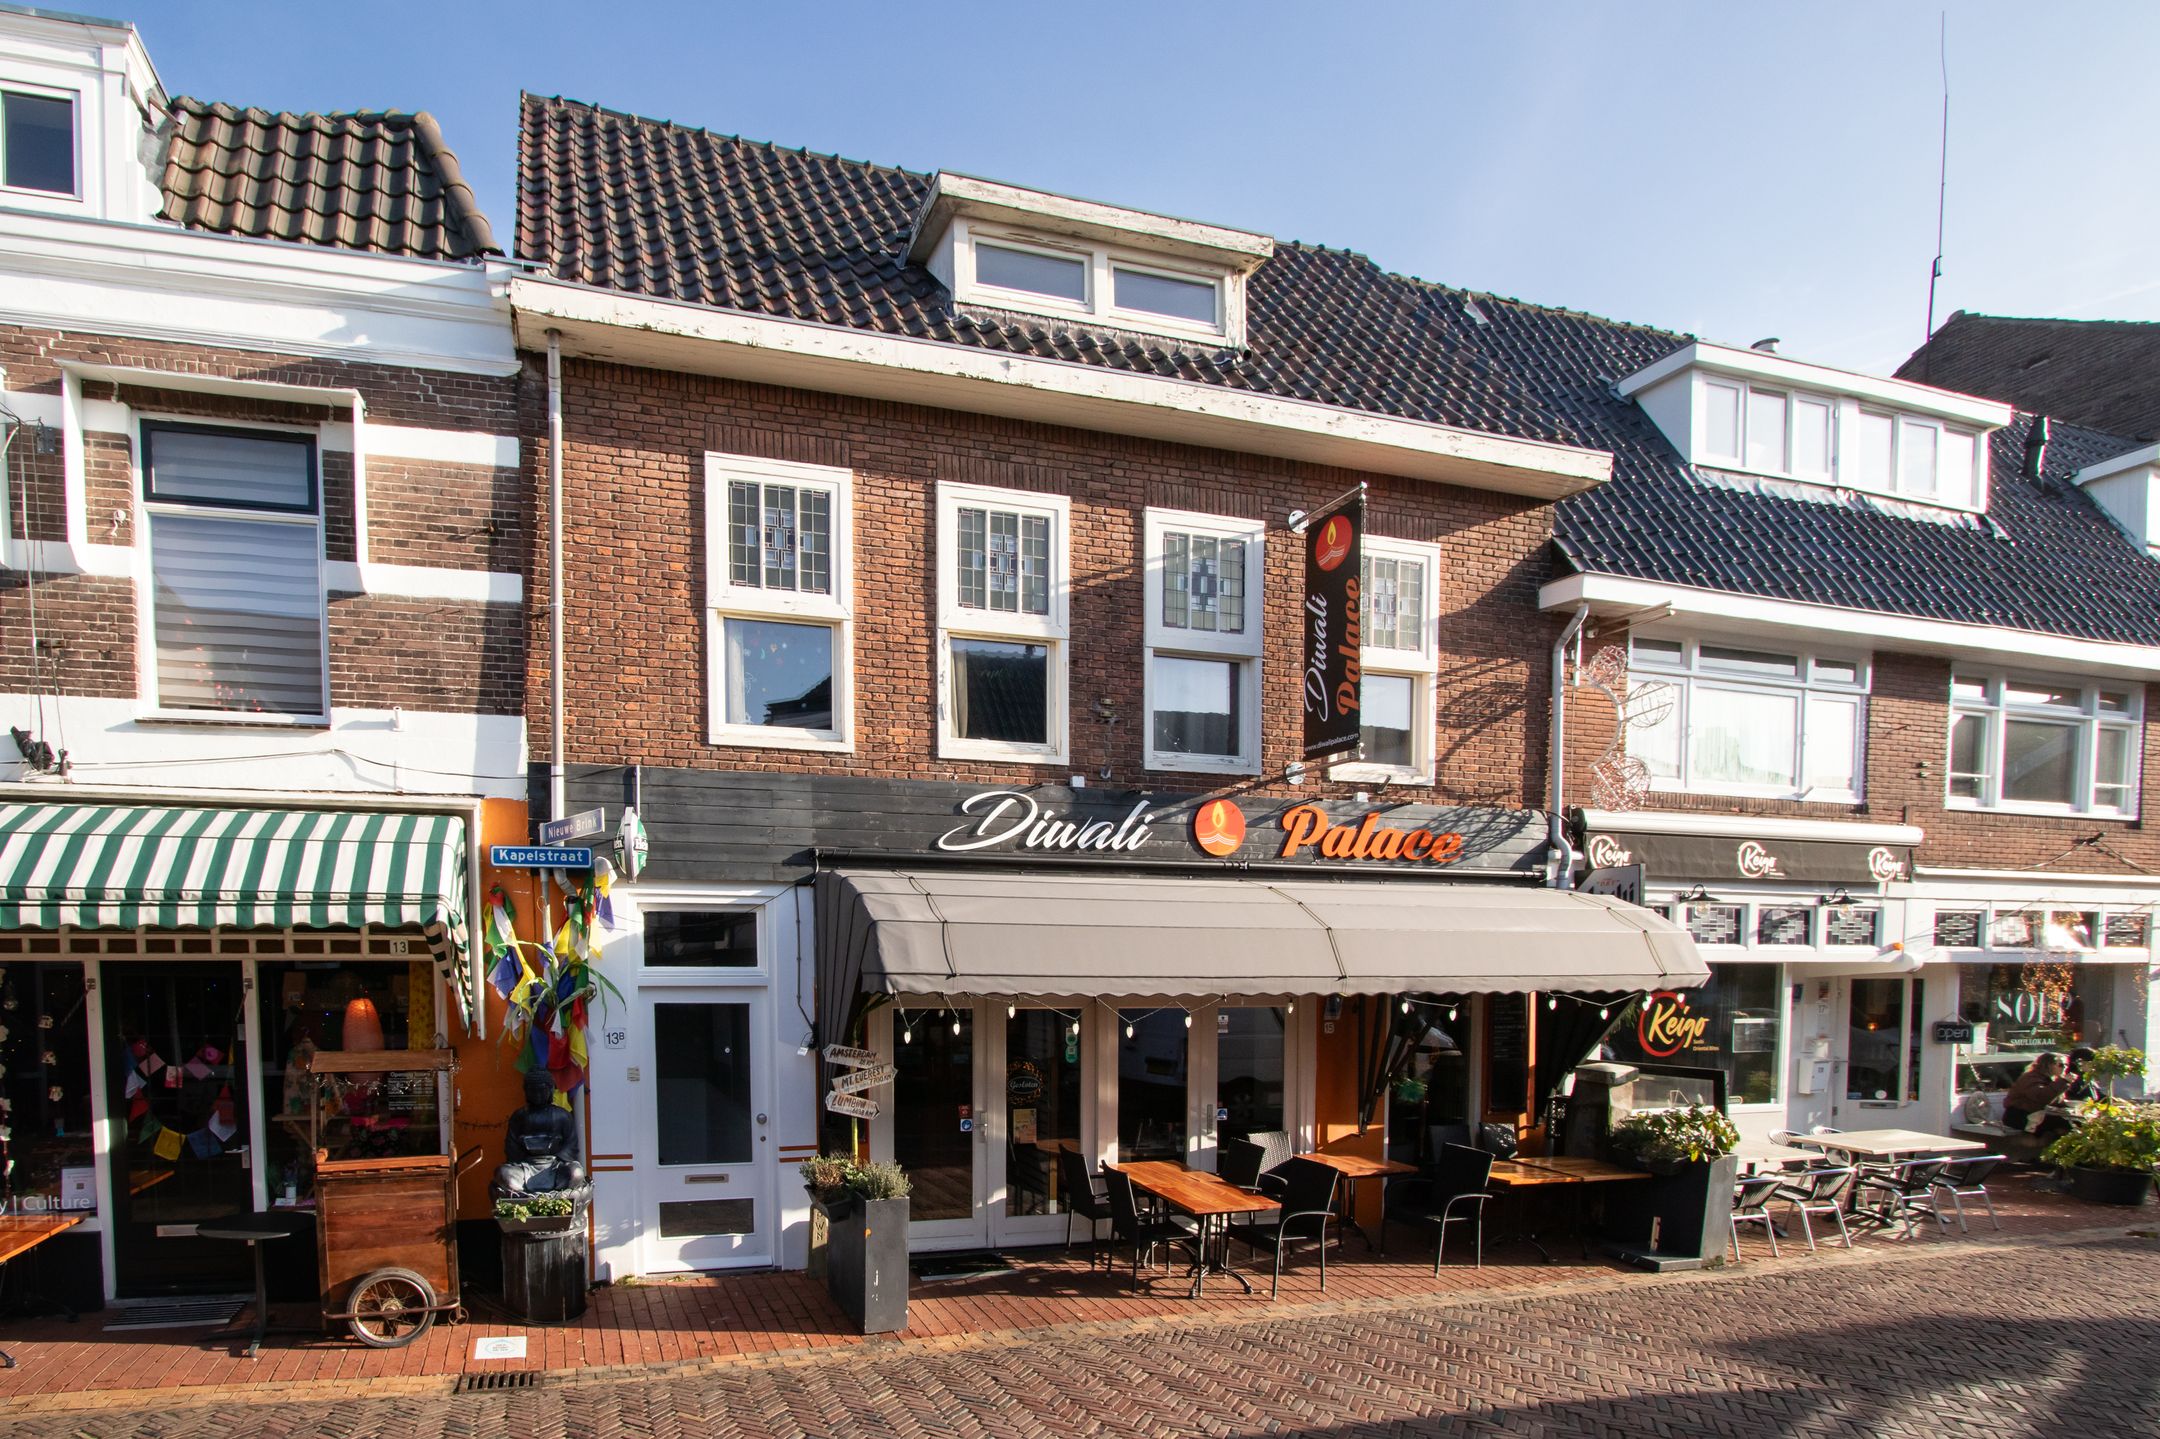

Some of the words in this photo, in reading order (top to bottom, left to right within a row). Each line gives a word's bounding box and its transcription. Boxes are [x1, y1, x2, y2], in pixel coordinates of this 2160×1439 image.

[1336, 575, 1360, 716] Palace
[1304, 592, 1328, 722] Diwali
[1304, 733, 1359, 752] www.diwalipalace.com
[548, 823, 574, 839] Nieuwe
[575, 816, 597, 831] Brink
[937, 790, 1154, 853] Diwali
[1281, 804, 1465, 863] Palace
[499, 849, 583, 863] Kapelstraat
[1596, 842, 1632, 868] Keigo
[1744, 847, 1778, 874] Keigo
[393, 941, 407, 953] 13
[1648, 1002, 1710, 1049] Keigo
[1936, 1026, 1970, 1041] open
[2010, 1038, 2057, 1046] SMULLOKAAL
[829, 1047, 877, 1060] AMSTERDAM
[854, 1065, 884, 1084] EVEREST
[23, 1194, 90, 1211] Culture
